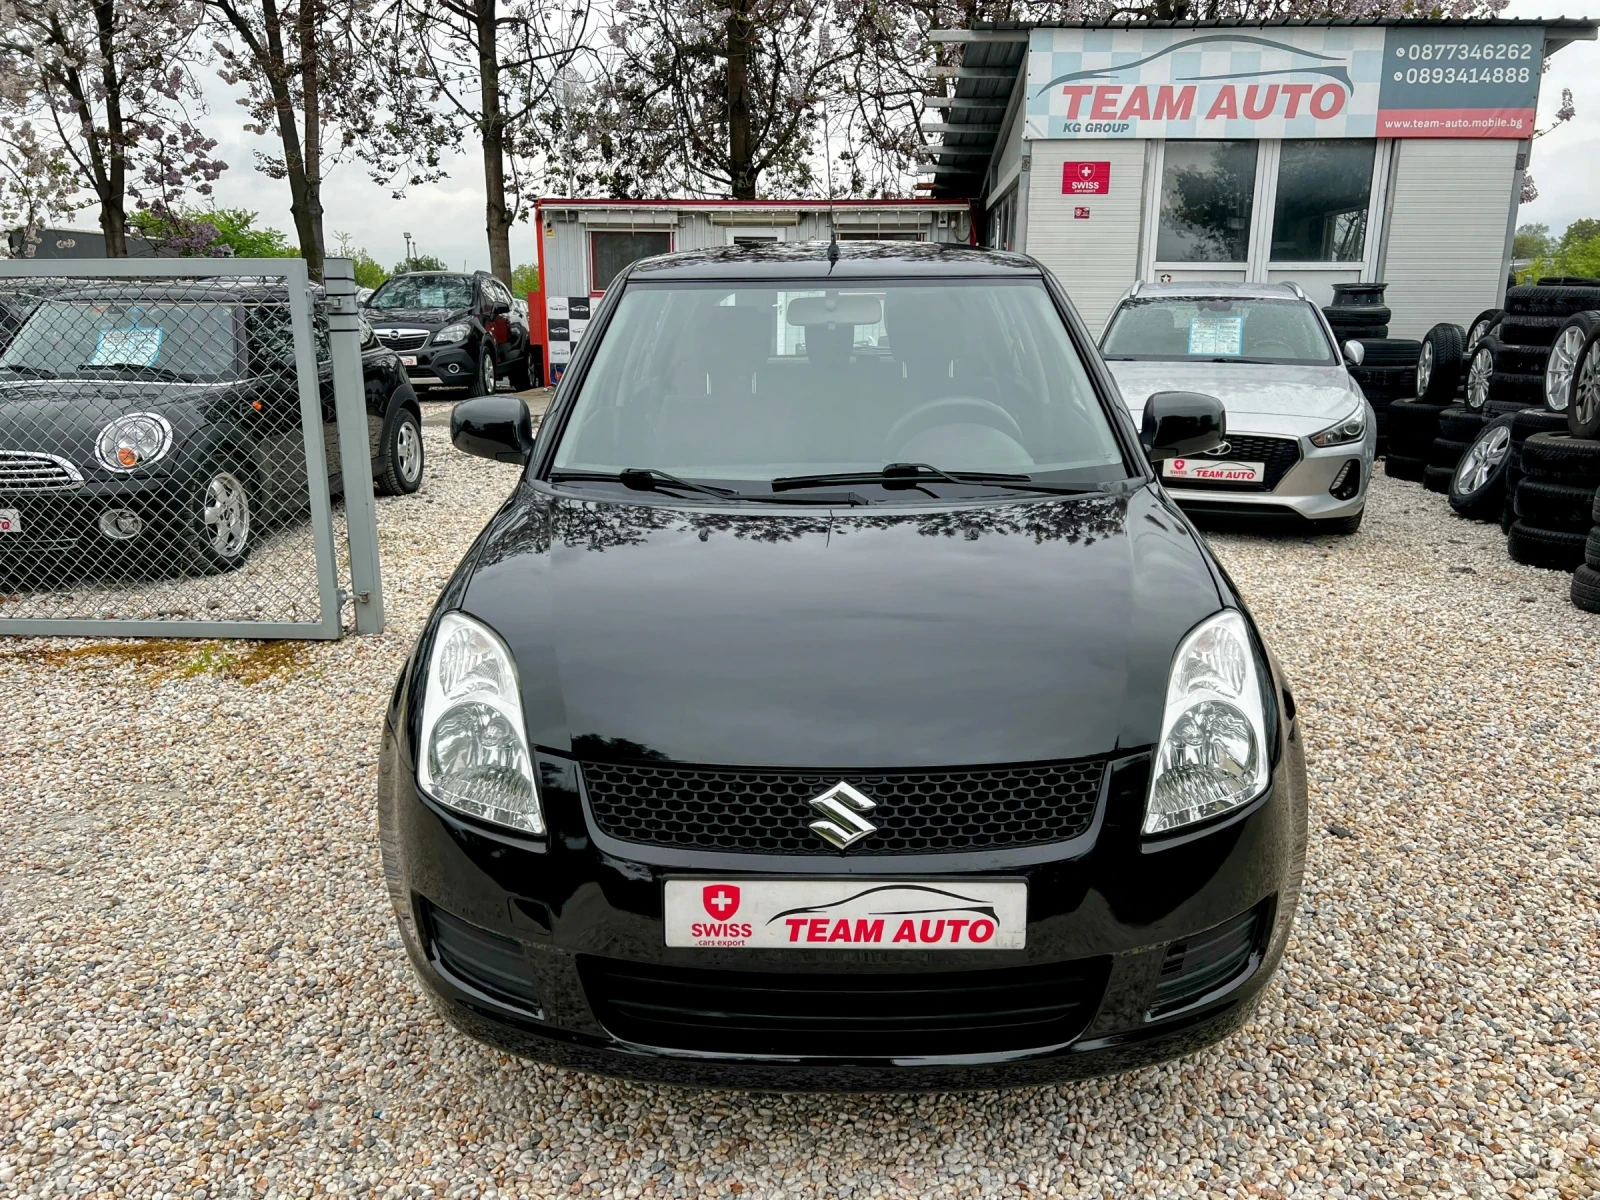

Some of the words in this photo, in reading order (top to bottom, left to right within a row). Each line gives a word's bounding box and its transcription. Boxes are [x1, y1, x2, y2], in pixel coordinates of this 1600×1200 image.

[1408, 43, 1532, 60] 0877346262
[1406, 67, 1530, 84] 0893414888
[1062, 85, 1197, 120] TEAM
[1205, 83, 1346, 120] AUTO
[1062, 123, 1081, 133] KG
[1085, 123, 1130, 133] GROUP
[1385, 118, 1523, 129] www.team-auto.mobile.bg
[1196, 470, 1224, 478] TEAM
[1225, 470, 1255, 480] AUTO
[691, 923, 752, 938] SWISS
[785, 919, 885, 943] TEAM
[892, 919, 995, 943] AUTO
[717, 939, 745, 948] export
